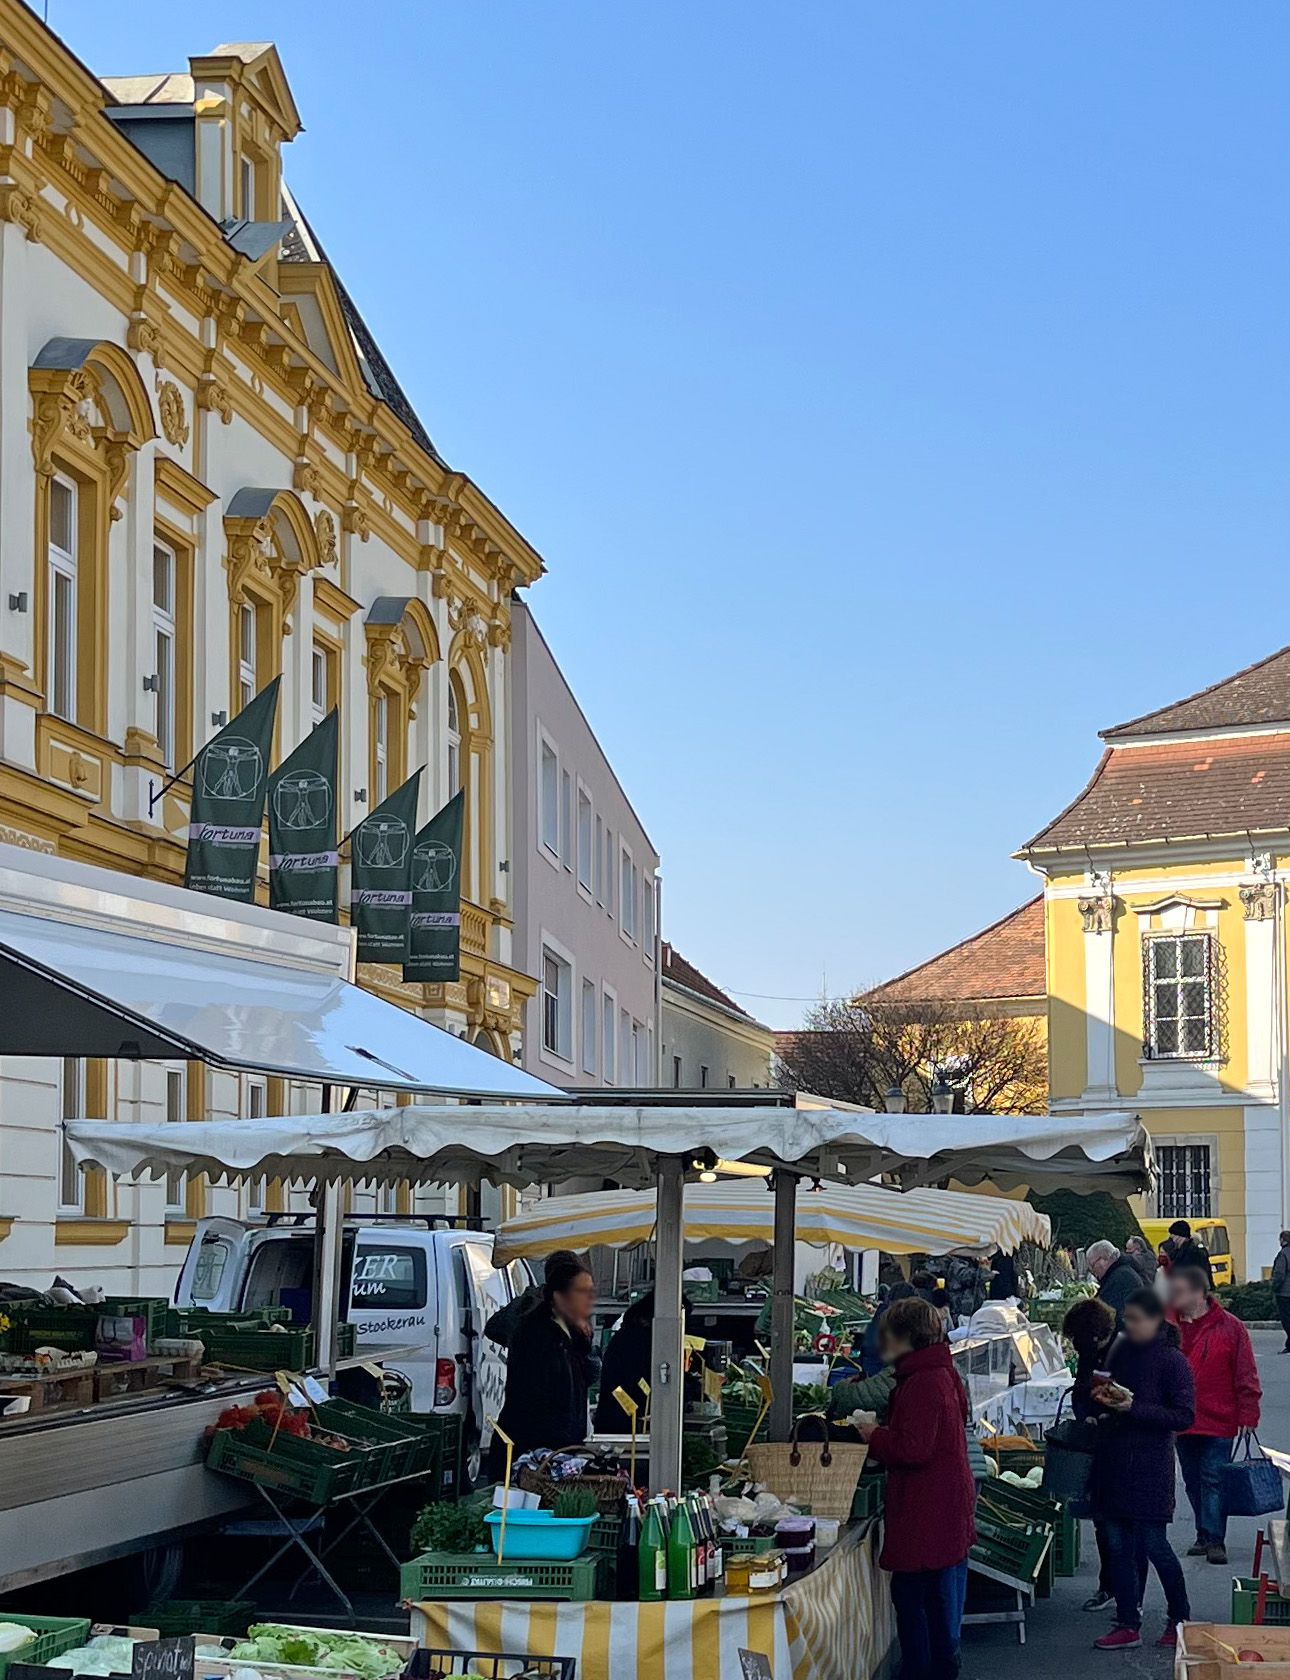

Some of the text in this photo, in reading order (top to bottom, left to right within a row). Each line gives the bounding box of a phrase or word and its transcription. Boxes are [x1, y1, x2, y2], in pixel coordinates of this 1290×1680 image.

[199, 822, 255, 841] fortuna
[278, 853, 330, 871] fortuna
[359, 888, 405, 905] fortuna
[410, 912, 453, 928] fortuna
